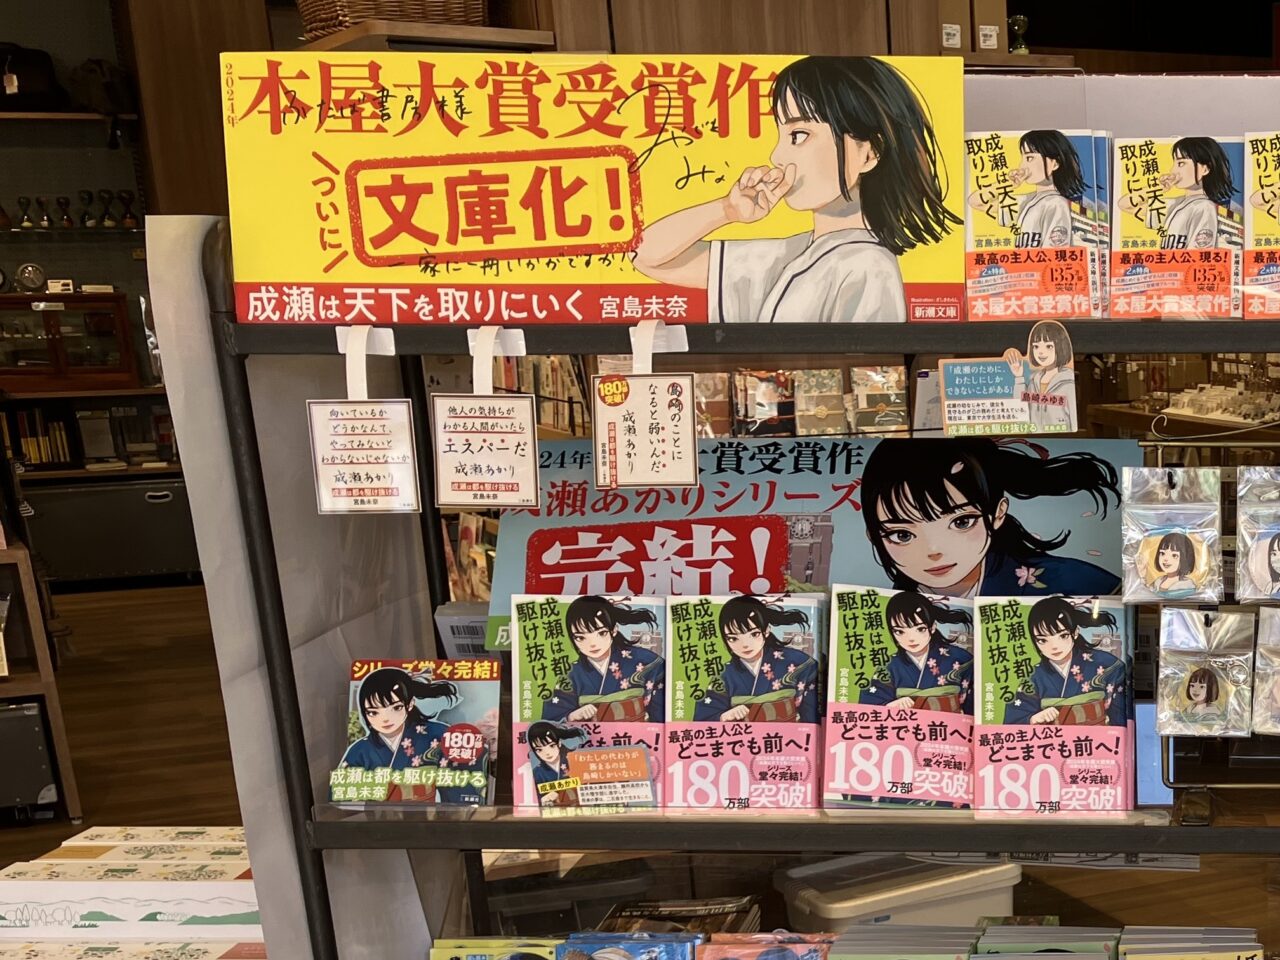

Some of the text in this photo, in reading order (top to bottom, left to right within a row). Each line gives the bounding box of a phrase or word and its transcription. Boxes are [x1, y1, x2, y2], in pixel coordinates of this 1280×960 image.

[225, 63, 239, 129] 2024年
[238, 58, 777, 140] 本屋大賞受賞作
[311, 176, 343, 252] ついに
[363, 165, 626, 250] 文庫化!
[974, 249, 1085, 265] 最高の主人公、現る!
[1119, 251, 1228, 265] 最高の主人公、現る!
[246, 285, 689, 322] 成瀬は天下を取りにいく 宮島未奈
[913, 305, 958, 319] 新潮文庫
[971, 293, 1091, 316] 本屋大賞受賞作
[1113, 294, 1231, 314] 本屋大賞受賞作
[954, 375, 1004, 385] わたしにしか
[945, 385, 1014, 396] できないことがある」
[1022, 392, 1066, 406] 島崎みゆき
[329, 408, 388, 418] 向いているか
[447, 405, 515, 417] 他人の気持ちが
[331, 423, 393, 434] どうかなんて、
[442, 421, 526, 432] わかる人間がいたら
[648, 383, 661, 474] なると弱いんだ
[329, 438, 393, 449] やってみないと
[442, 440, 528, 457] エスパーだ
[621, 409, 638, 475] 成瀬あかり
[321, 453, 411, 464] わからないじゃないか
[333, 469, 394, 485] 成瀬あかり
[453, 461, 516, 478] 成瀬あかり
[830, 709, 919, 724] 最高の主人公と
[668, 724, 754, 745] 最高の主人公と
[840, 721, 974, 742] どこまでも前へ!
[979, 726, 1064, 746] 最高の主人公と
[677, 732, 811, 760] どこまでも前へ!
[987, 736, 1121, 763] どこまでも前へ!
[330, 767, 487, 788] 成瀬は都を駆け抜ける
[539, 778, 579, 793] 成瀬あかり
[332, 785, 386, 799] 宮島未奈
